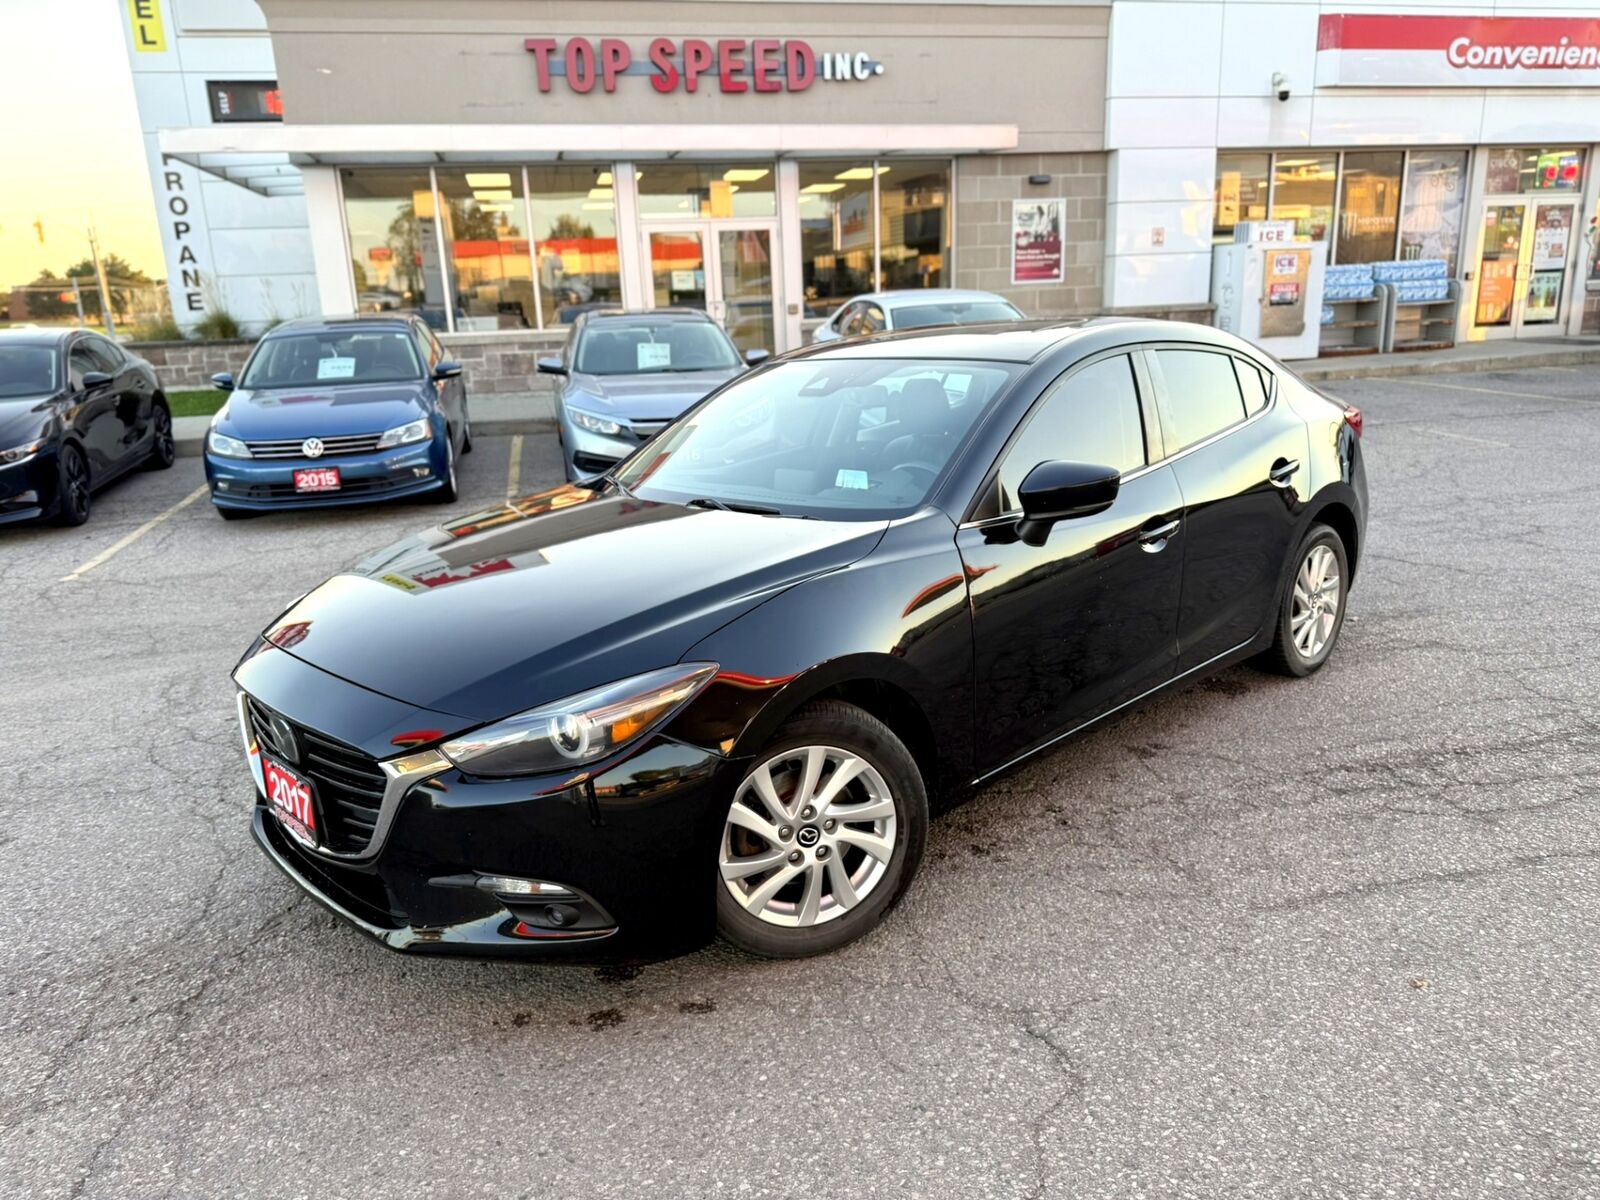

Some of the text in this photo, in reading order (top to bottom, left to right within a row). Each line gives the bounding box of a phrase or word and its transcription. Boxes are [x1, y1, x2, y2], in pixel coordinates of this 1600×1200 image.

[524, 37, 885, 93] TOP SPEED INC.
[1447, 36, 1600, 68] Convenien
[1259, 230, 1284, 242] ICE
[297, 472, 337, 488] 2015
[269, 770, 310, 826] 2017
